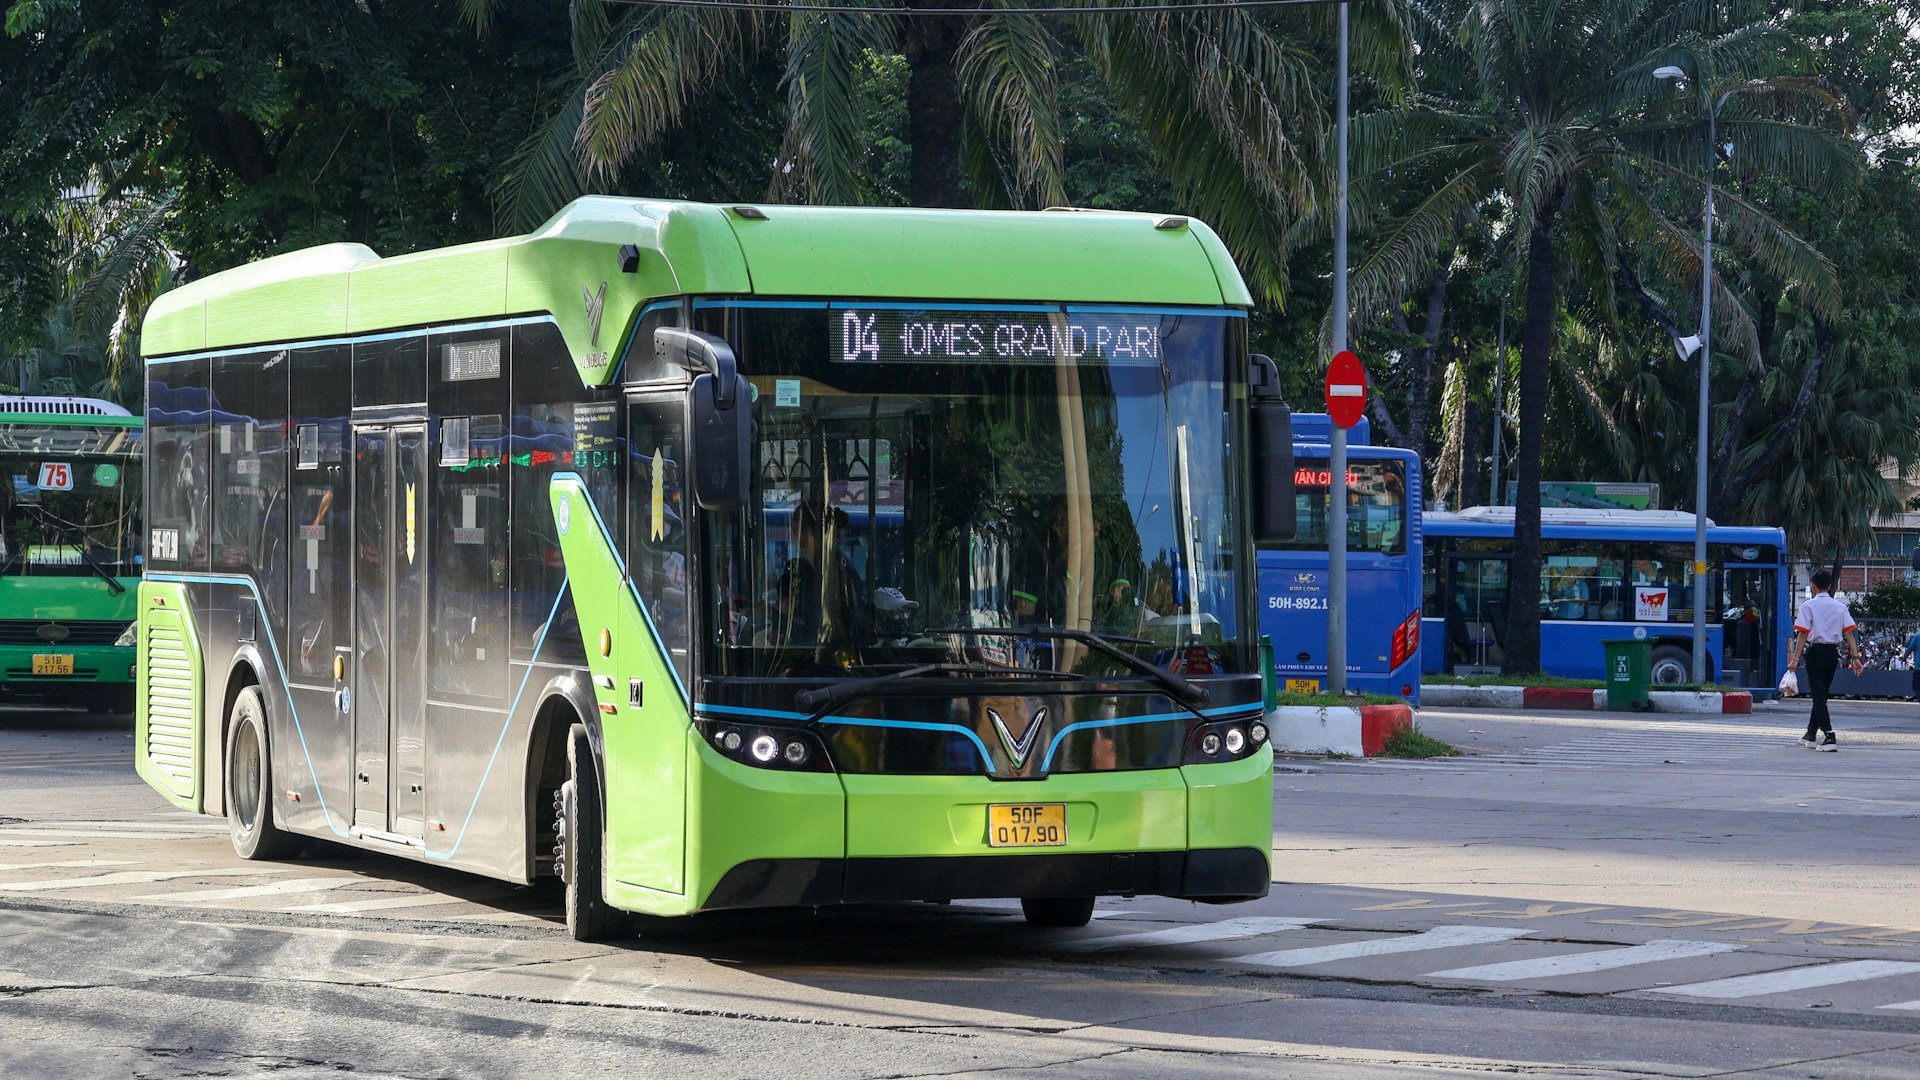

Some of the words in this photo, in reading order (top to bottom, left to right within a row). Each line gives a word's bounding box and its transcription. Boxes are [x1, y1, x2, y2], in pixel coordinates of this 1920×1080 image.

[843, 312, 880, 361] D4
[994, 324, 1087, 357] GRAND
[450, 346, 461, 379] D4
[44, 464, 67, 487] 75
[1268, 597, 1328, 610] 50H-892.1
[44, 656, 62, 665] 51B
[37, 665, 69, 674] 217.56
[1295, 680, 1310, 688] 50H
[1011, 807, 1044, 824] 50F
[998, 825, 1058, 843] 017.90
